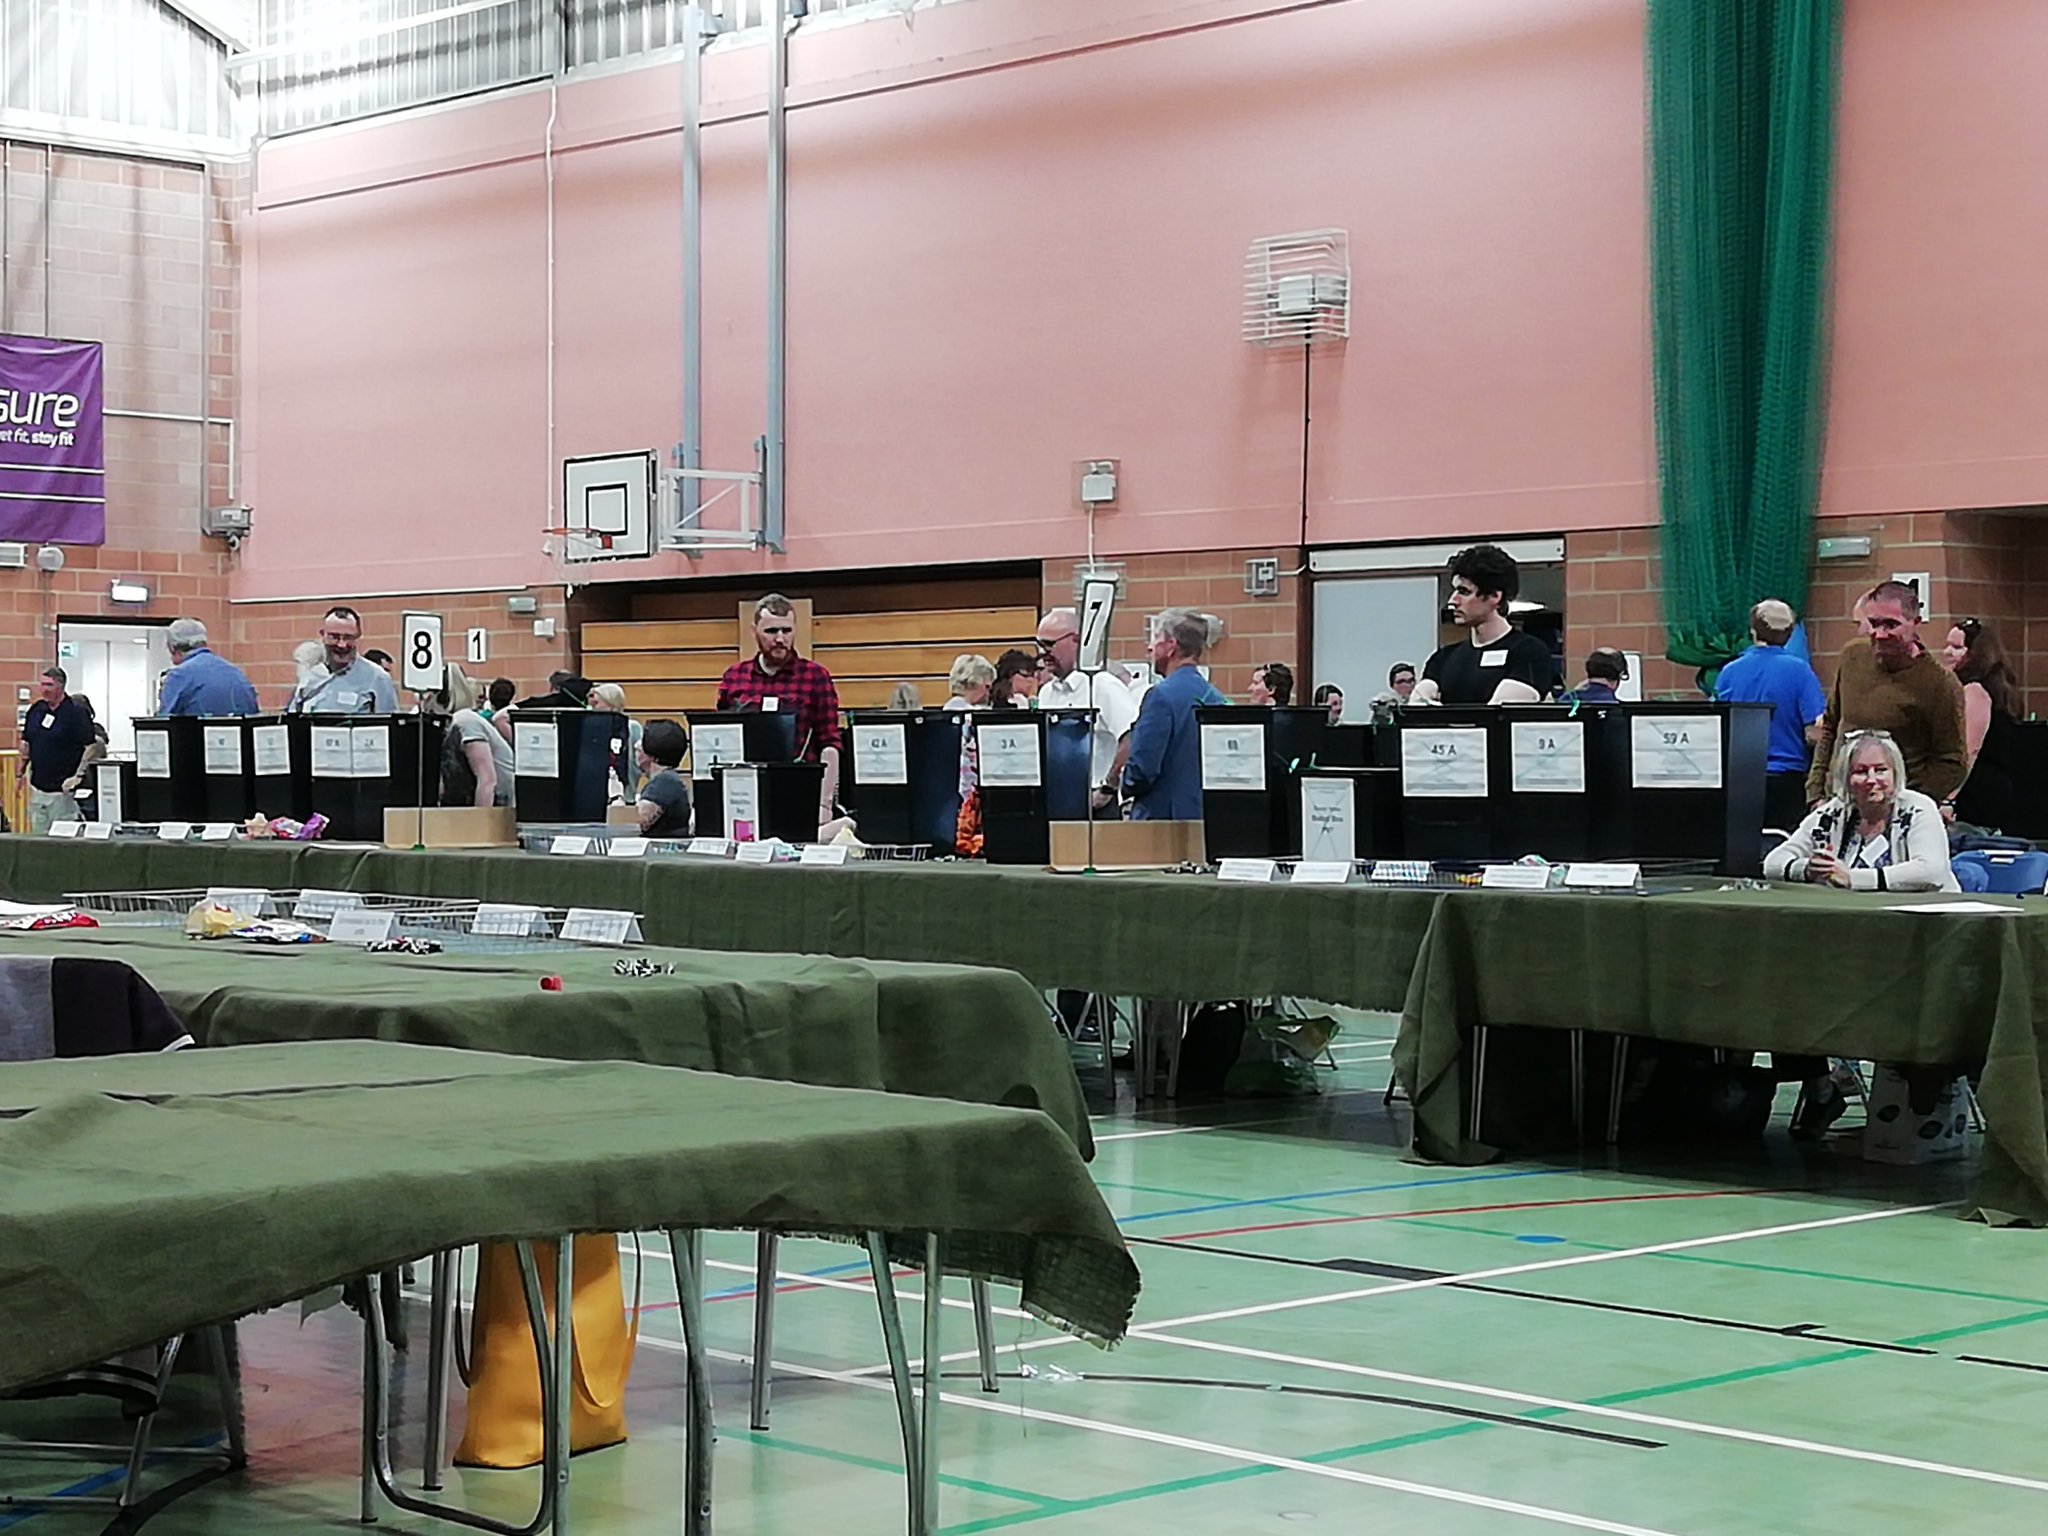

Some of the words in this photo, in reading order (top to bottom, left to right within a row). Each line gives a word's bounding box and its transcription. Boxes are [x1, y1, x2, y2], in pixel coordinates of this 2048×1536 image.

[31, 431, 58, 449] stay
[59, 431, 74, 446] fit
[1083, 601, 1103, 647] 7
[412, 631, 432, 669] 8
[472, 630, 482, 660] 1
[1009, 738, 1017, 750] A
[1547, 738, 1556, 750] A
[1680, 732, 1690, 744] A
[1431, 744, 1446, 756] 45
[1447, 744, 1457, 755] A
